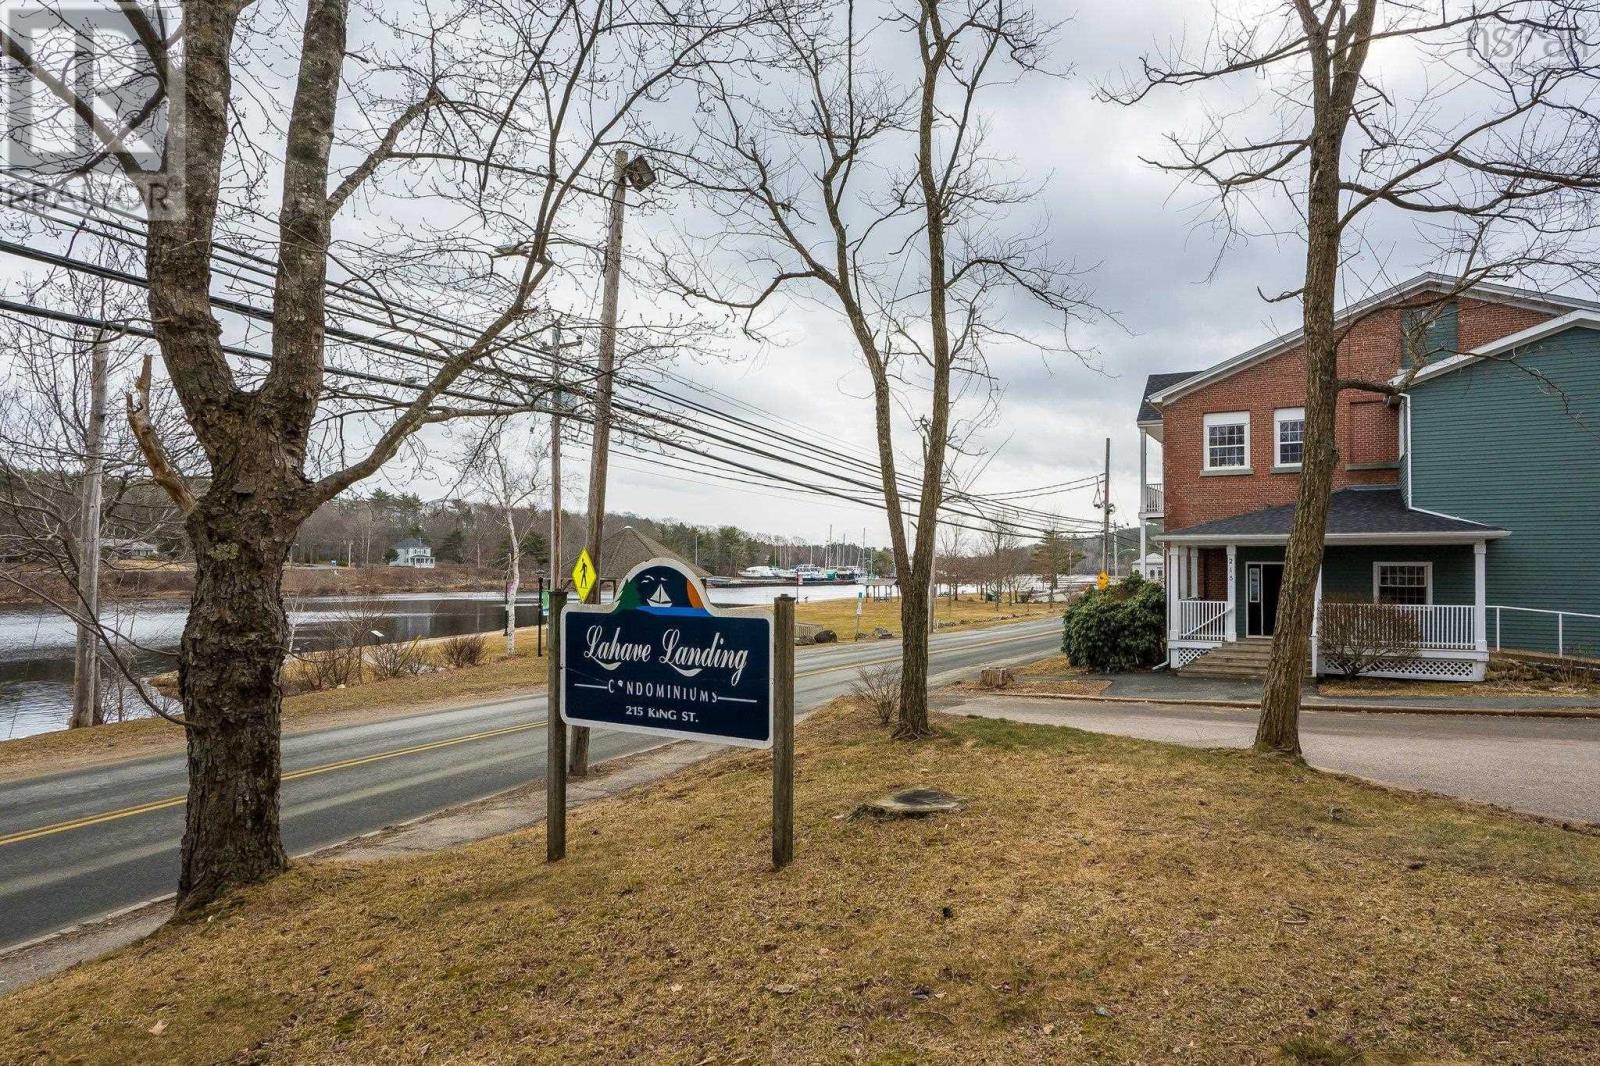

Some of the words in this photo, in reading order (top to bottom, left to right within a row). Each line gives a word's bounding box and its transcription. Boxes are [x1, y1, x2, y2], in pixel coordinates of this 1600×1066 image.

[584, 625, 652, 670] Lahave
[658, 629, 749, 686] Landing
[625, 705, 644, 716] 215
[648, 707, 677, 720] KING
[681, 711, 699, 723] ST.
